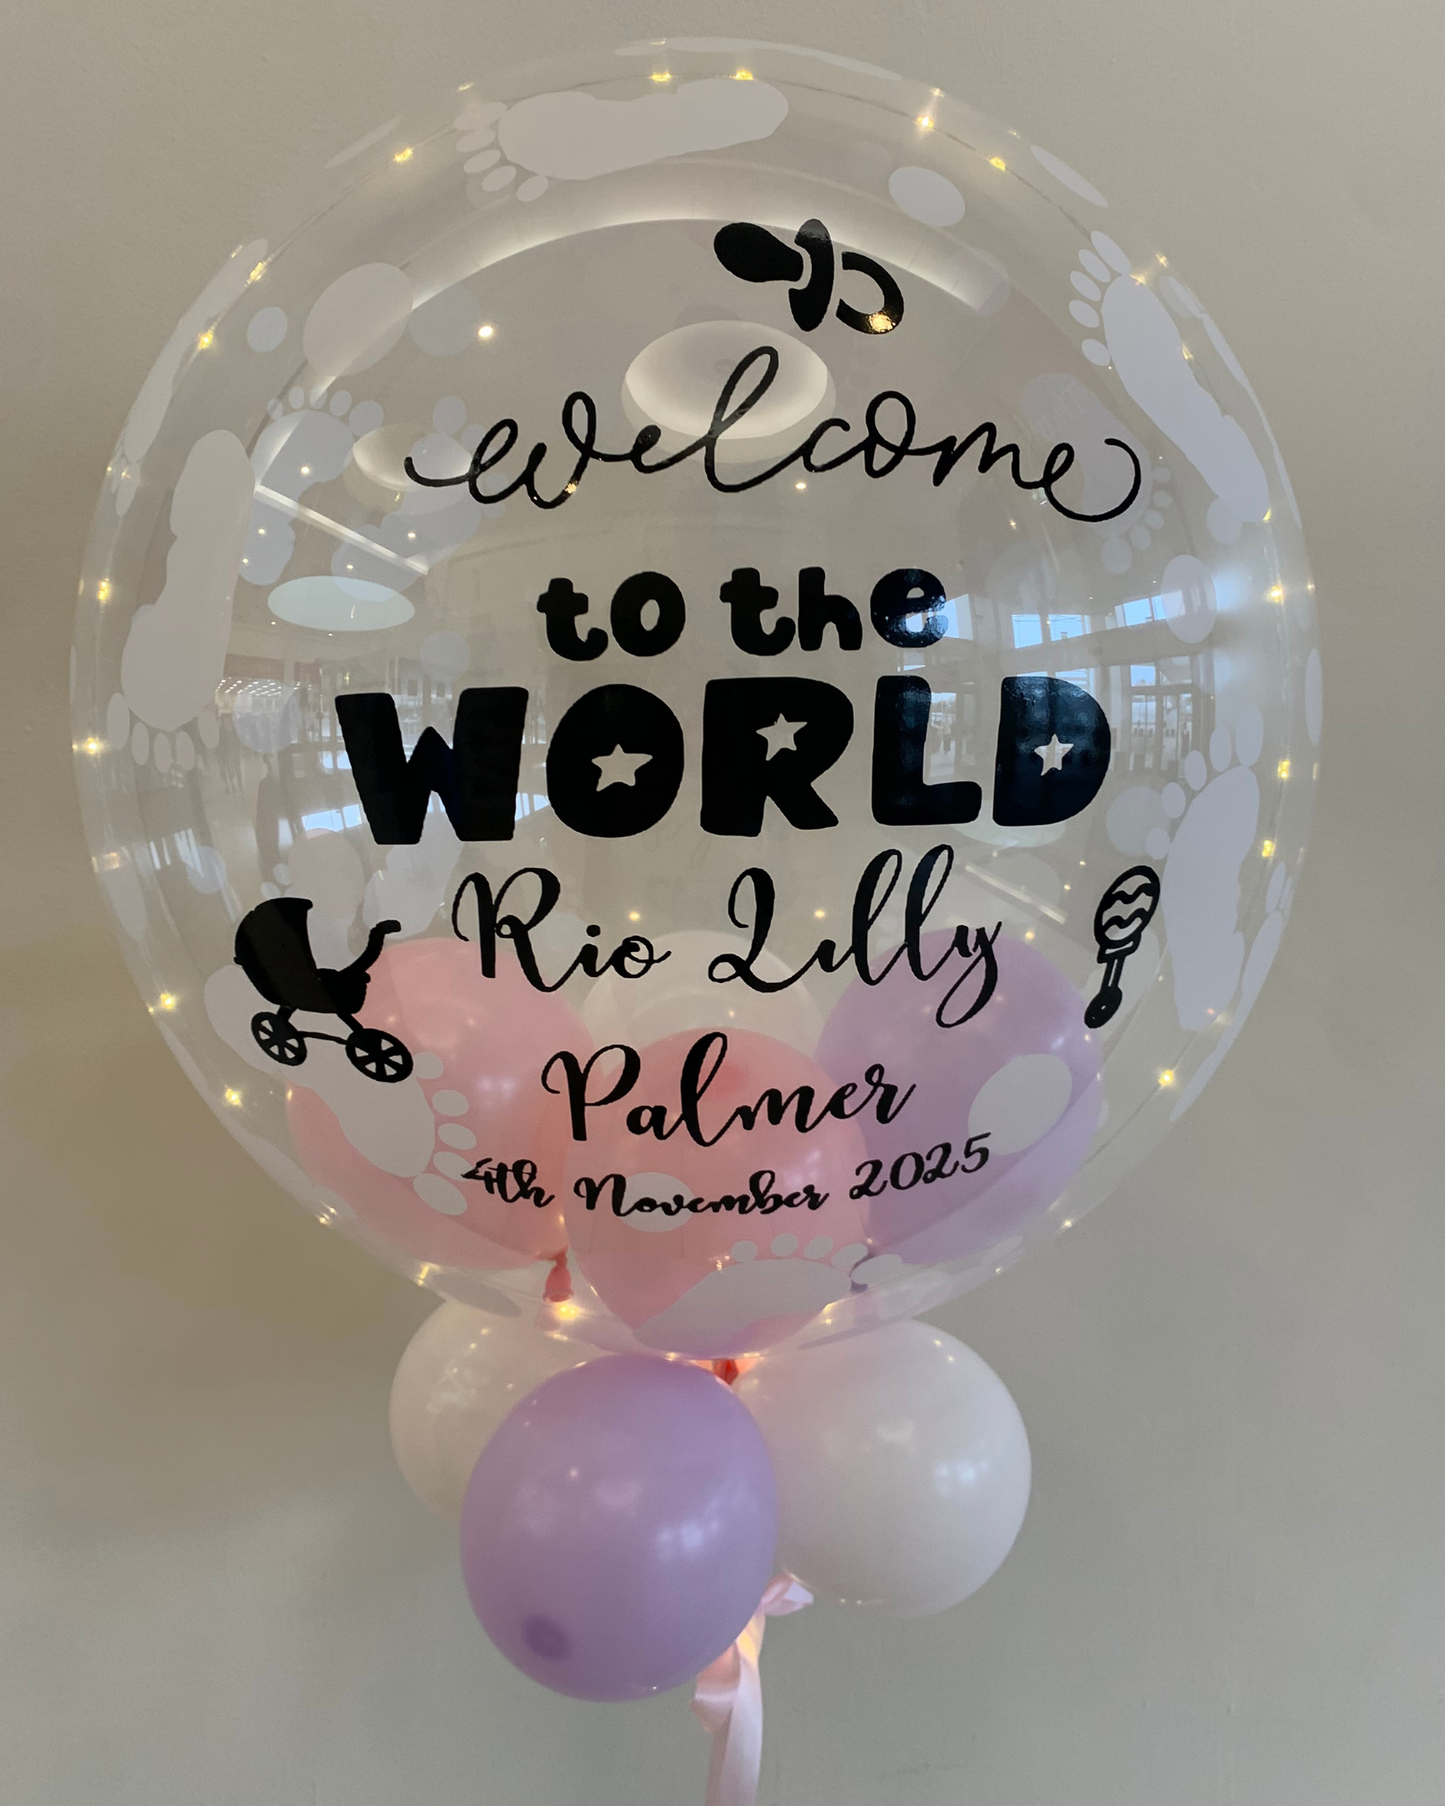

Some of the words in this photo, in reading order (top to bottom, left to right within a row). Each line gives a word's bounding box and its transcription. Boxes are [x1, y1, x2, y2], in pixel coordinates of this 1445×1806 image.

[537, 571, 686, 661] to
[720, 567, 947, 656] the
[335, 676, 1112, 846] WORLD
[452, 868, 671, 992] Rio
[708, 844, 1002, 1029] Lilly
[541, 1032, 917, 1148] Palmer
[461, 1157, 556, 1209] 4th
[573, 1169, 830, 1217] November
[849, 1132, 992, 1200] 2025
